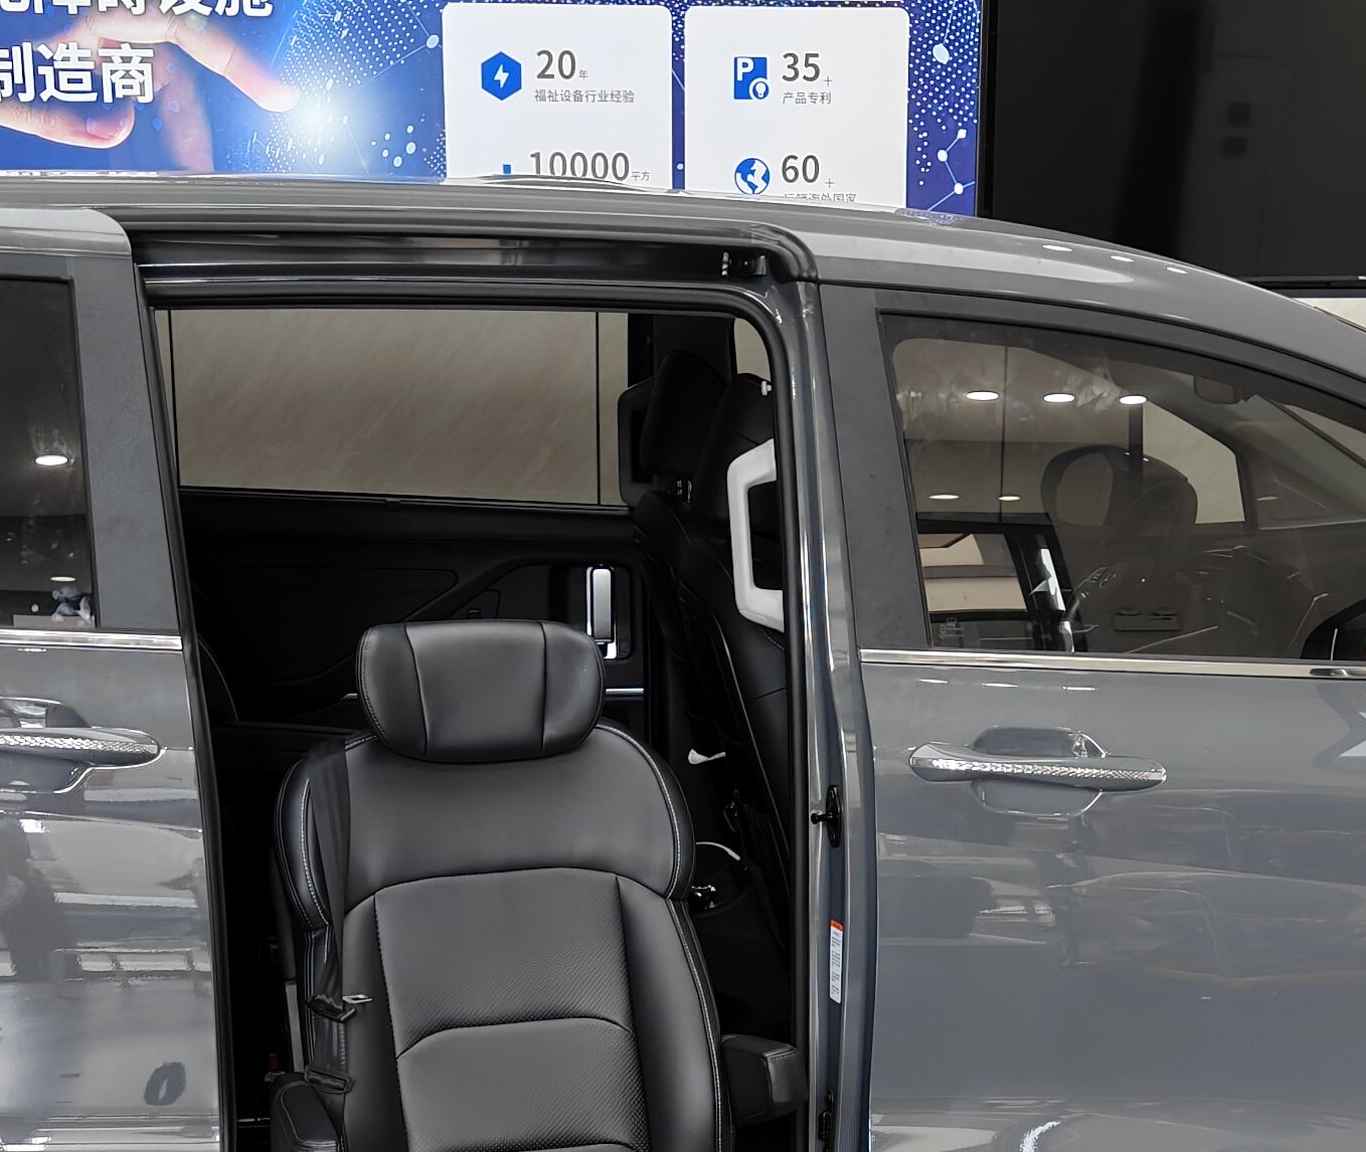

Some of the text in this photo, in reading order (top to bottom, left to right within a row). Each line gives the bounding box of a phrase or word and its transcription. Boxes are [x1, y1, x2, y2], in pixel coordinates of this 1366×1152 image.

[534, 89, 634, 103] 福祉设备行业经验
[782, 91, 832, 105] 产品专利
